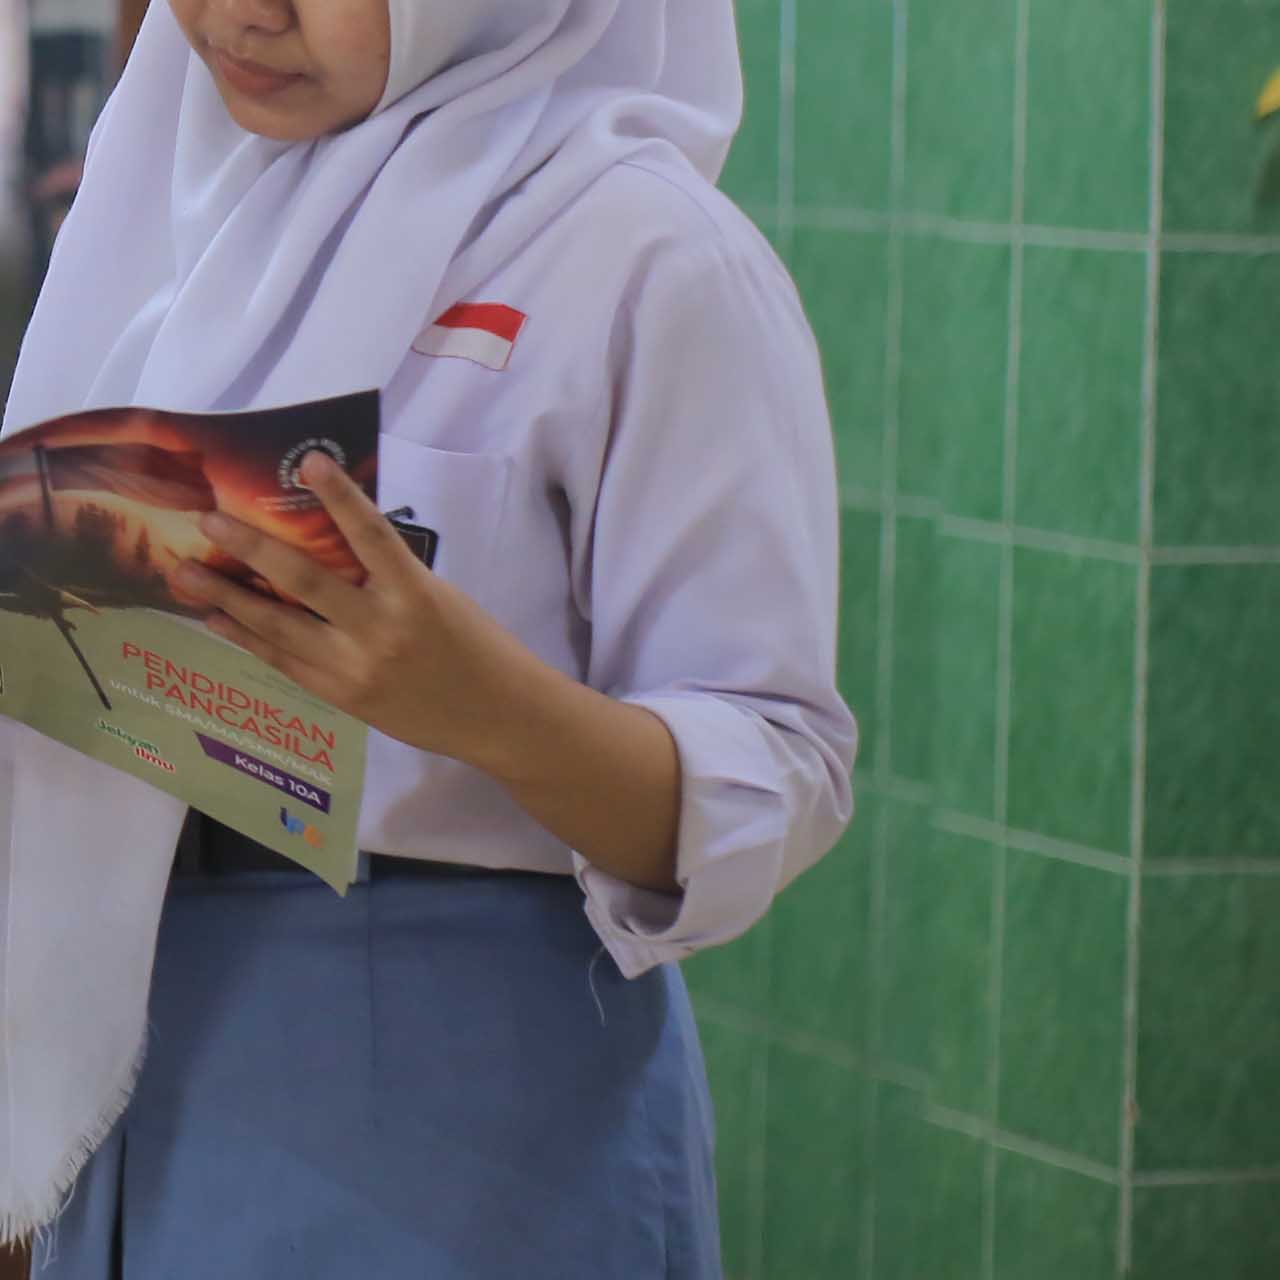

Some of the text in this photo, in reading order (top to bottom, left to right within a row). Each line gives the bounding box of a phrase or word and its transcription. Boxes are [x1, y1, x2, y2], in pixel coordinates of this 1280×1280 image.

[121, 641, 336, 750] PENDIDIKAN
[146, 672, 337, 773] PANCASILA
[235, 753, 322, 806] Kelas 10A
